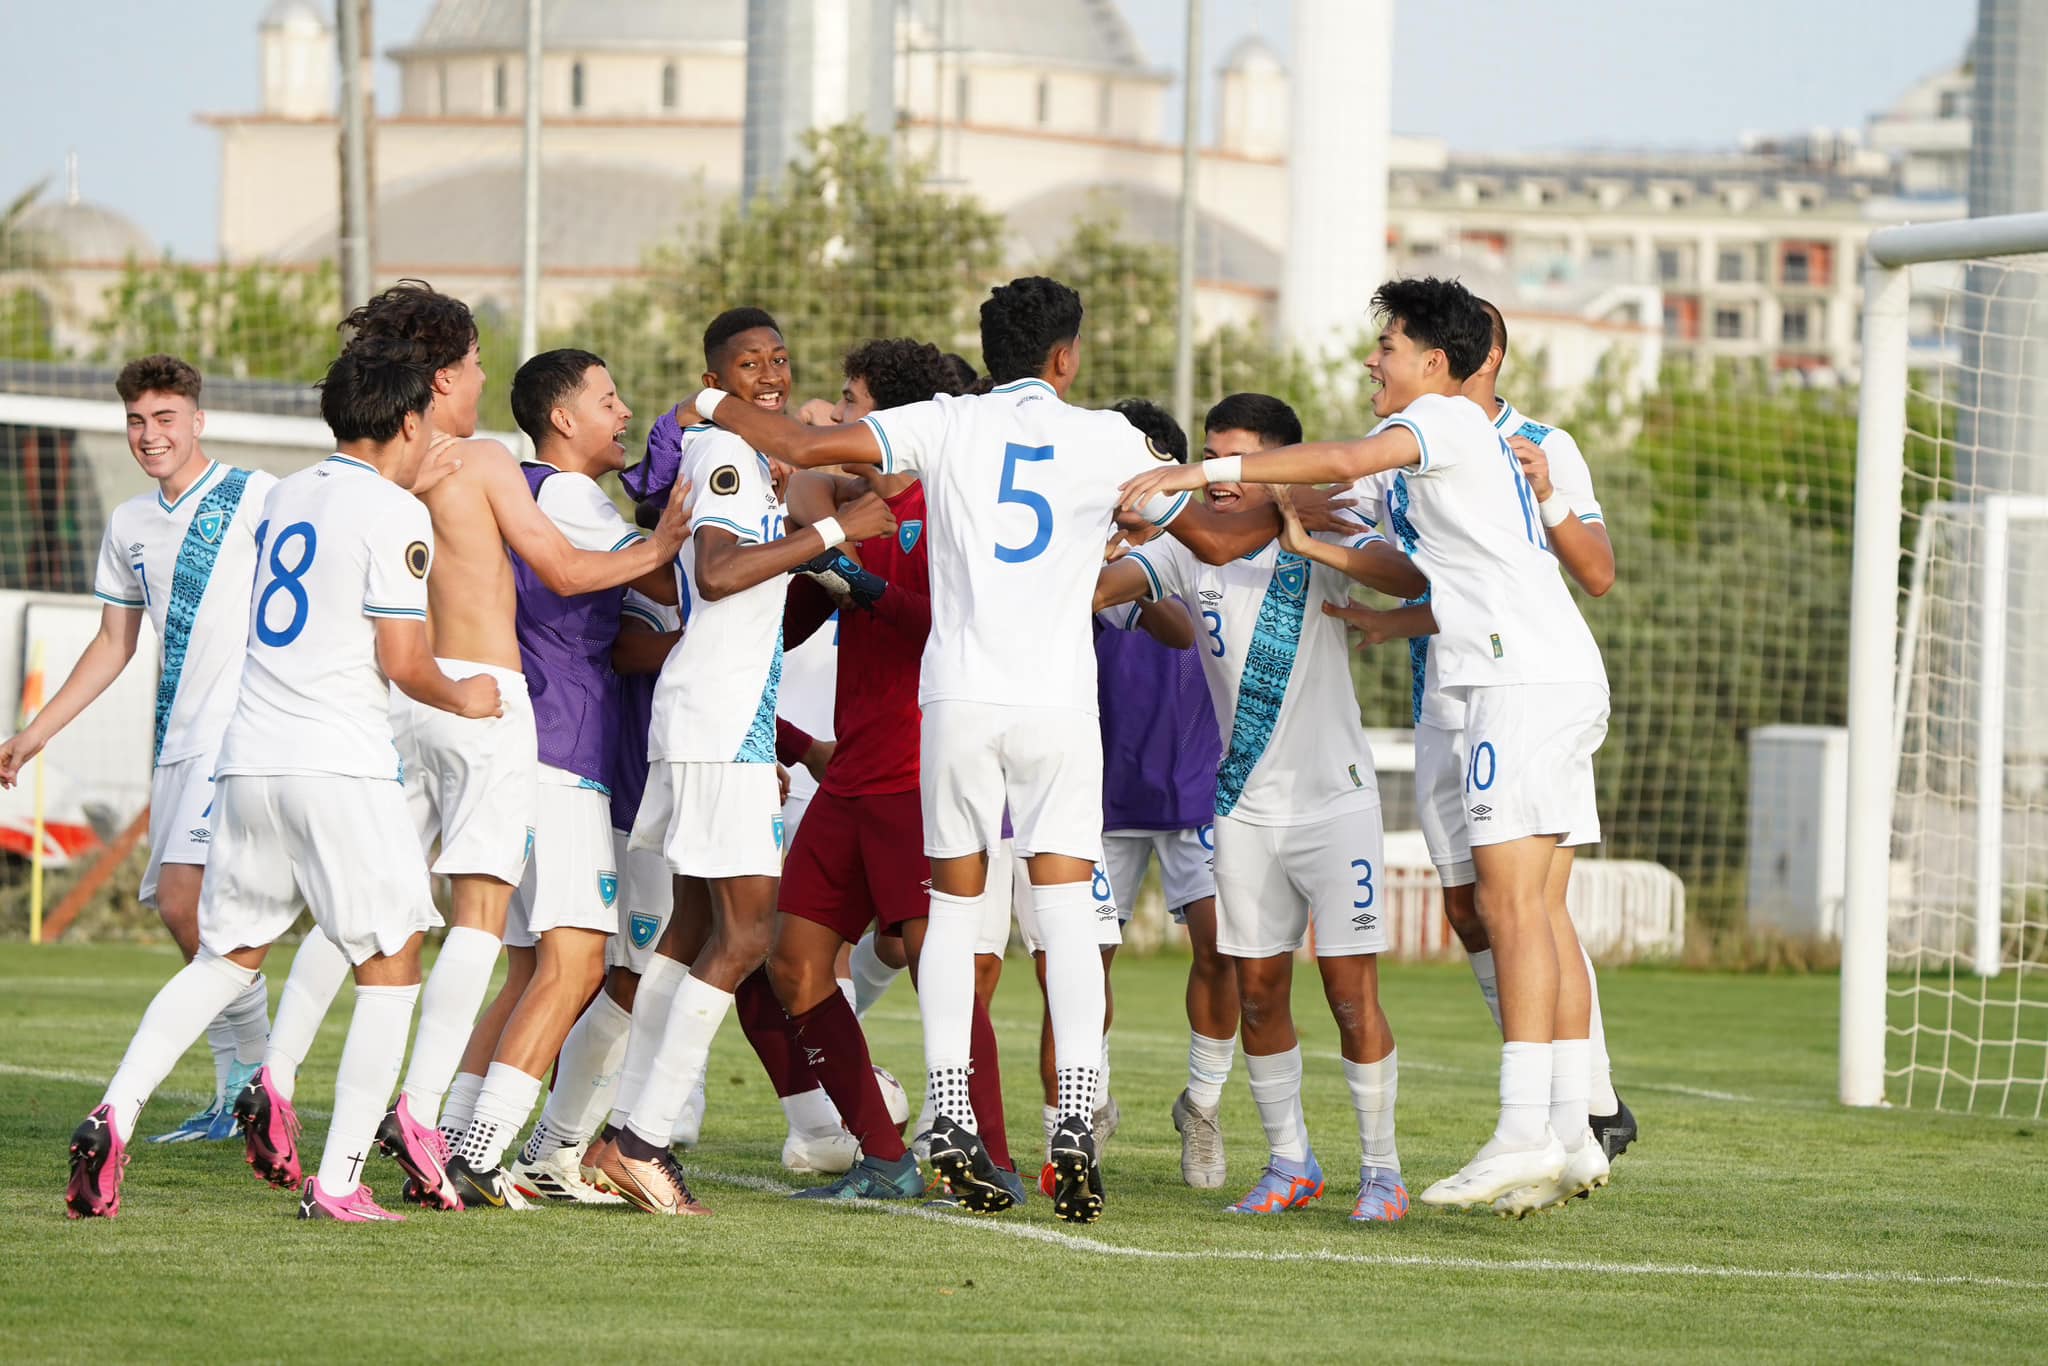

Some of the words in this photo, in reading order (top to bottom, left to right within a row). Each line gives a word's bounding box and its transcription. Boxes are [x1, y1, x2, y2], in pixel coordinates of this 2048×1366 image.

[994, 441, 1055, 564] 5
[133, 563, 152, 607] 7
[1202, 610, 1226, 658] 3
[1351, 858, 1374, 909] 3
